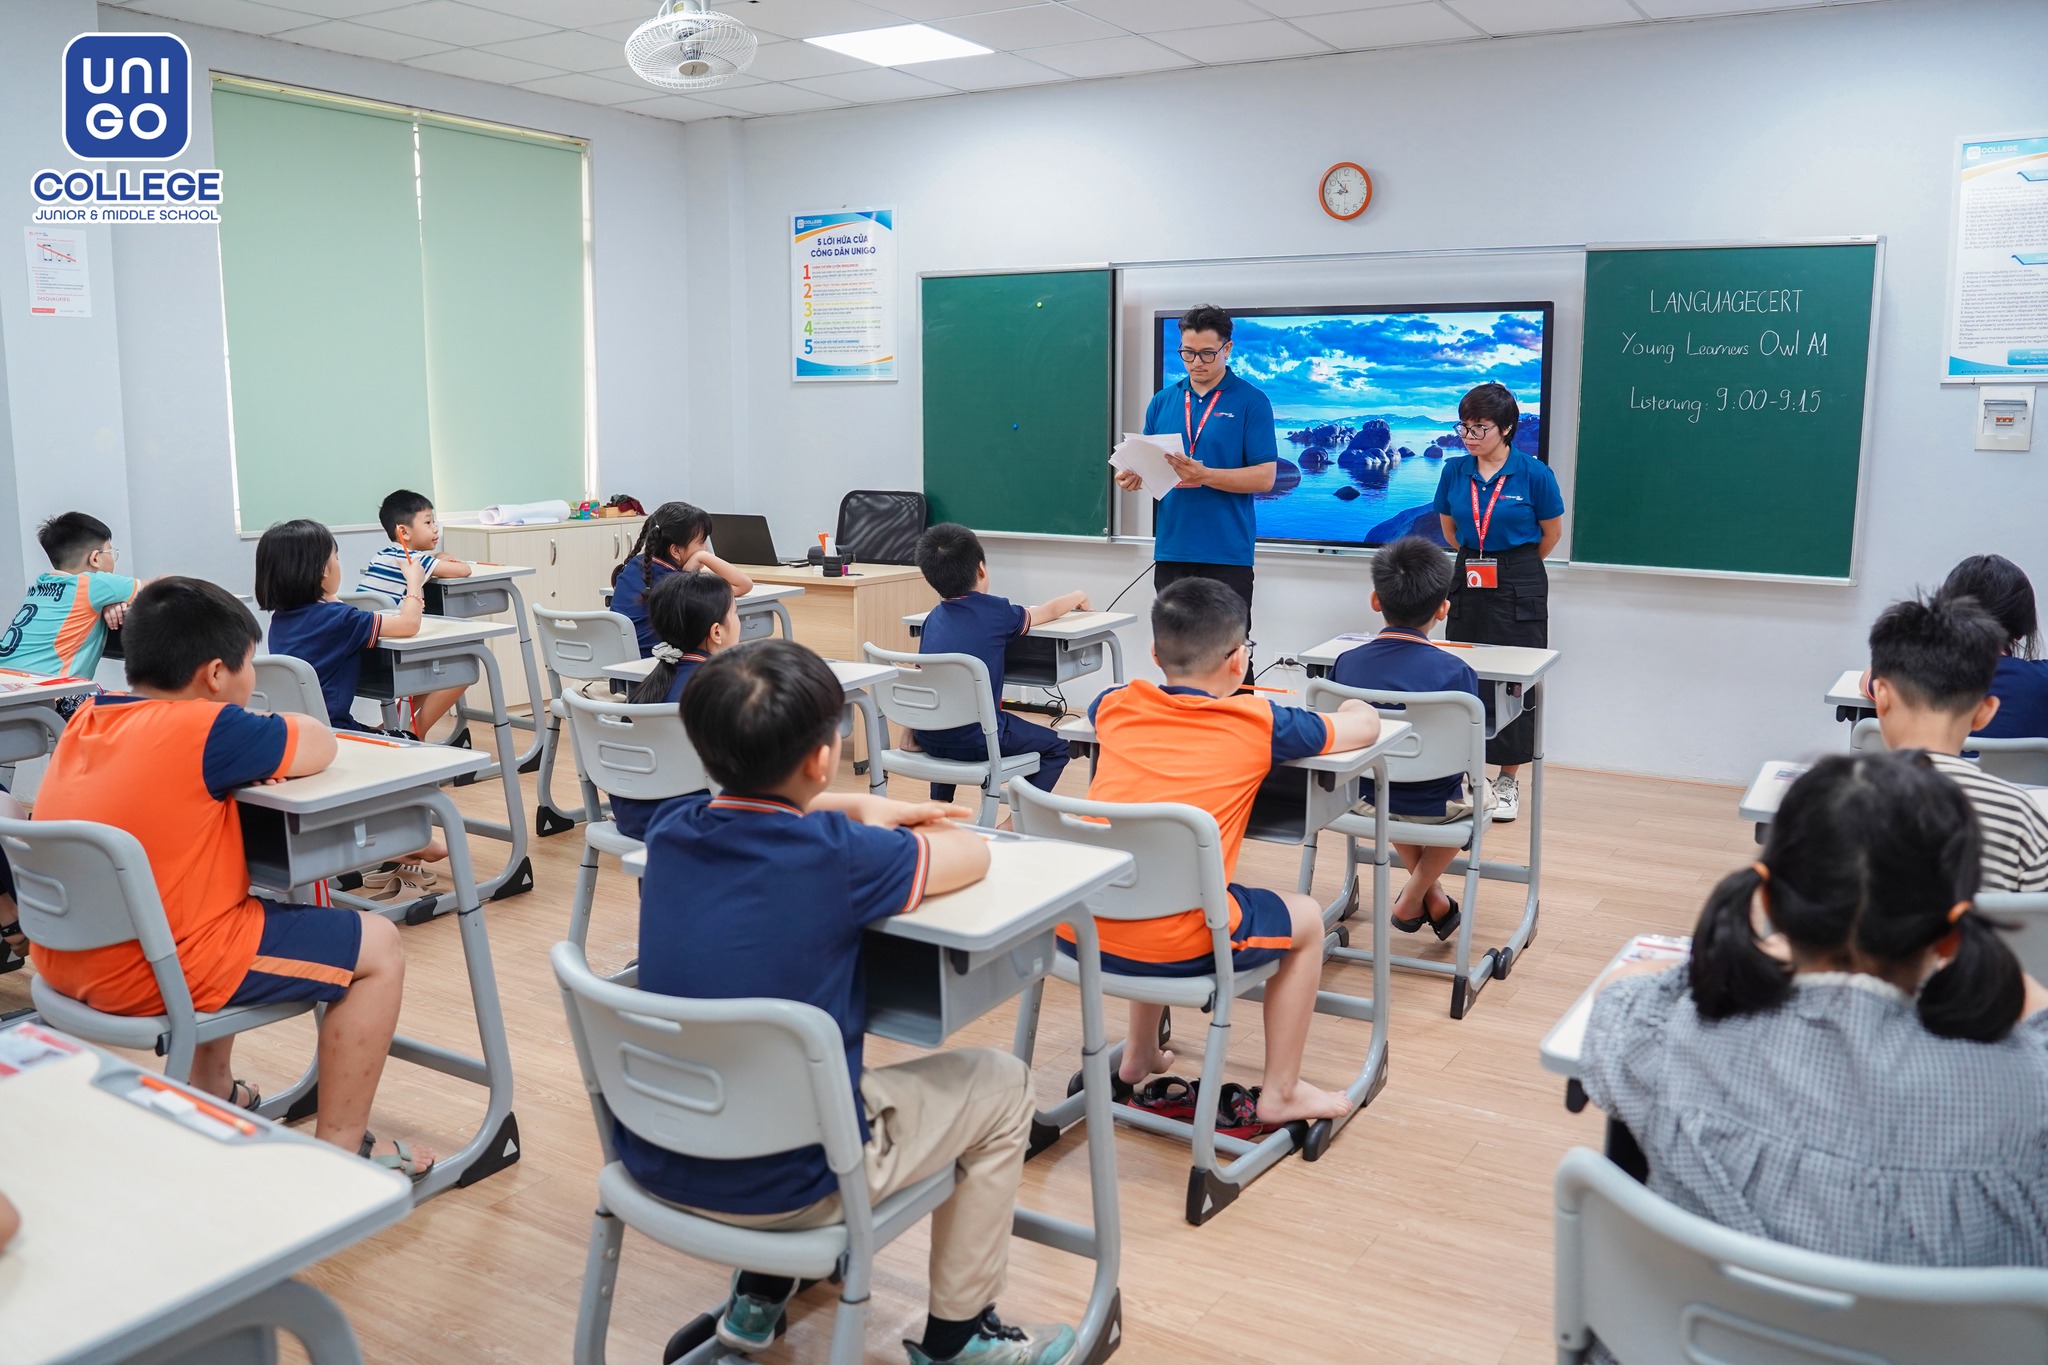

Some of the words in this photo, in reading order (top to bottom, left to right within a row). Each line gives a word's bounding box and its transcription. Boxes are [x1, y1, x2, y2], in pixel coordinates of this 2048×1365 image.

[1981, 145, 2018, 154] COLLEGE
[1343, 168, 1350, 177] 12
[1360, 177, 1365, 185] 2
[1326, 188, 1331, 196] 9
[1329, 198, 1334, 206] 8
[1336, 204, 1341, 212] 7
[1344, 206, 1350, 215] 6
[817, 238, 822, 246] 5
[810, 248, 833, 258] CÔNG
[834, 247, 850, 257] DÂN
[851, 246, 876, 255] UNIGO
[803, 264, 811, 280] 1
[803, 283, 812, 299] 2
[1650, 289, 1803, 314] LANGUAGECERT
[803, 301, 813, 318] 3
[803, 320, 813, 336] 4
[804, 339, 813, 355] 5
[1621, 331, 1675, 364] Young
[1686, 331, 1749, 356] Learners
[1759, 329, 1800, 356] Owl
[1807, 331, 1828, 356] A1
